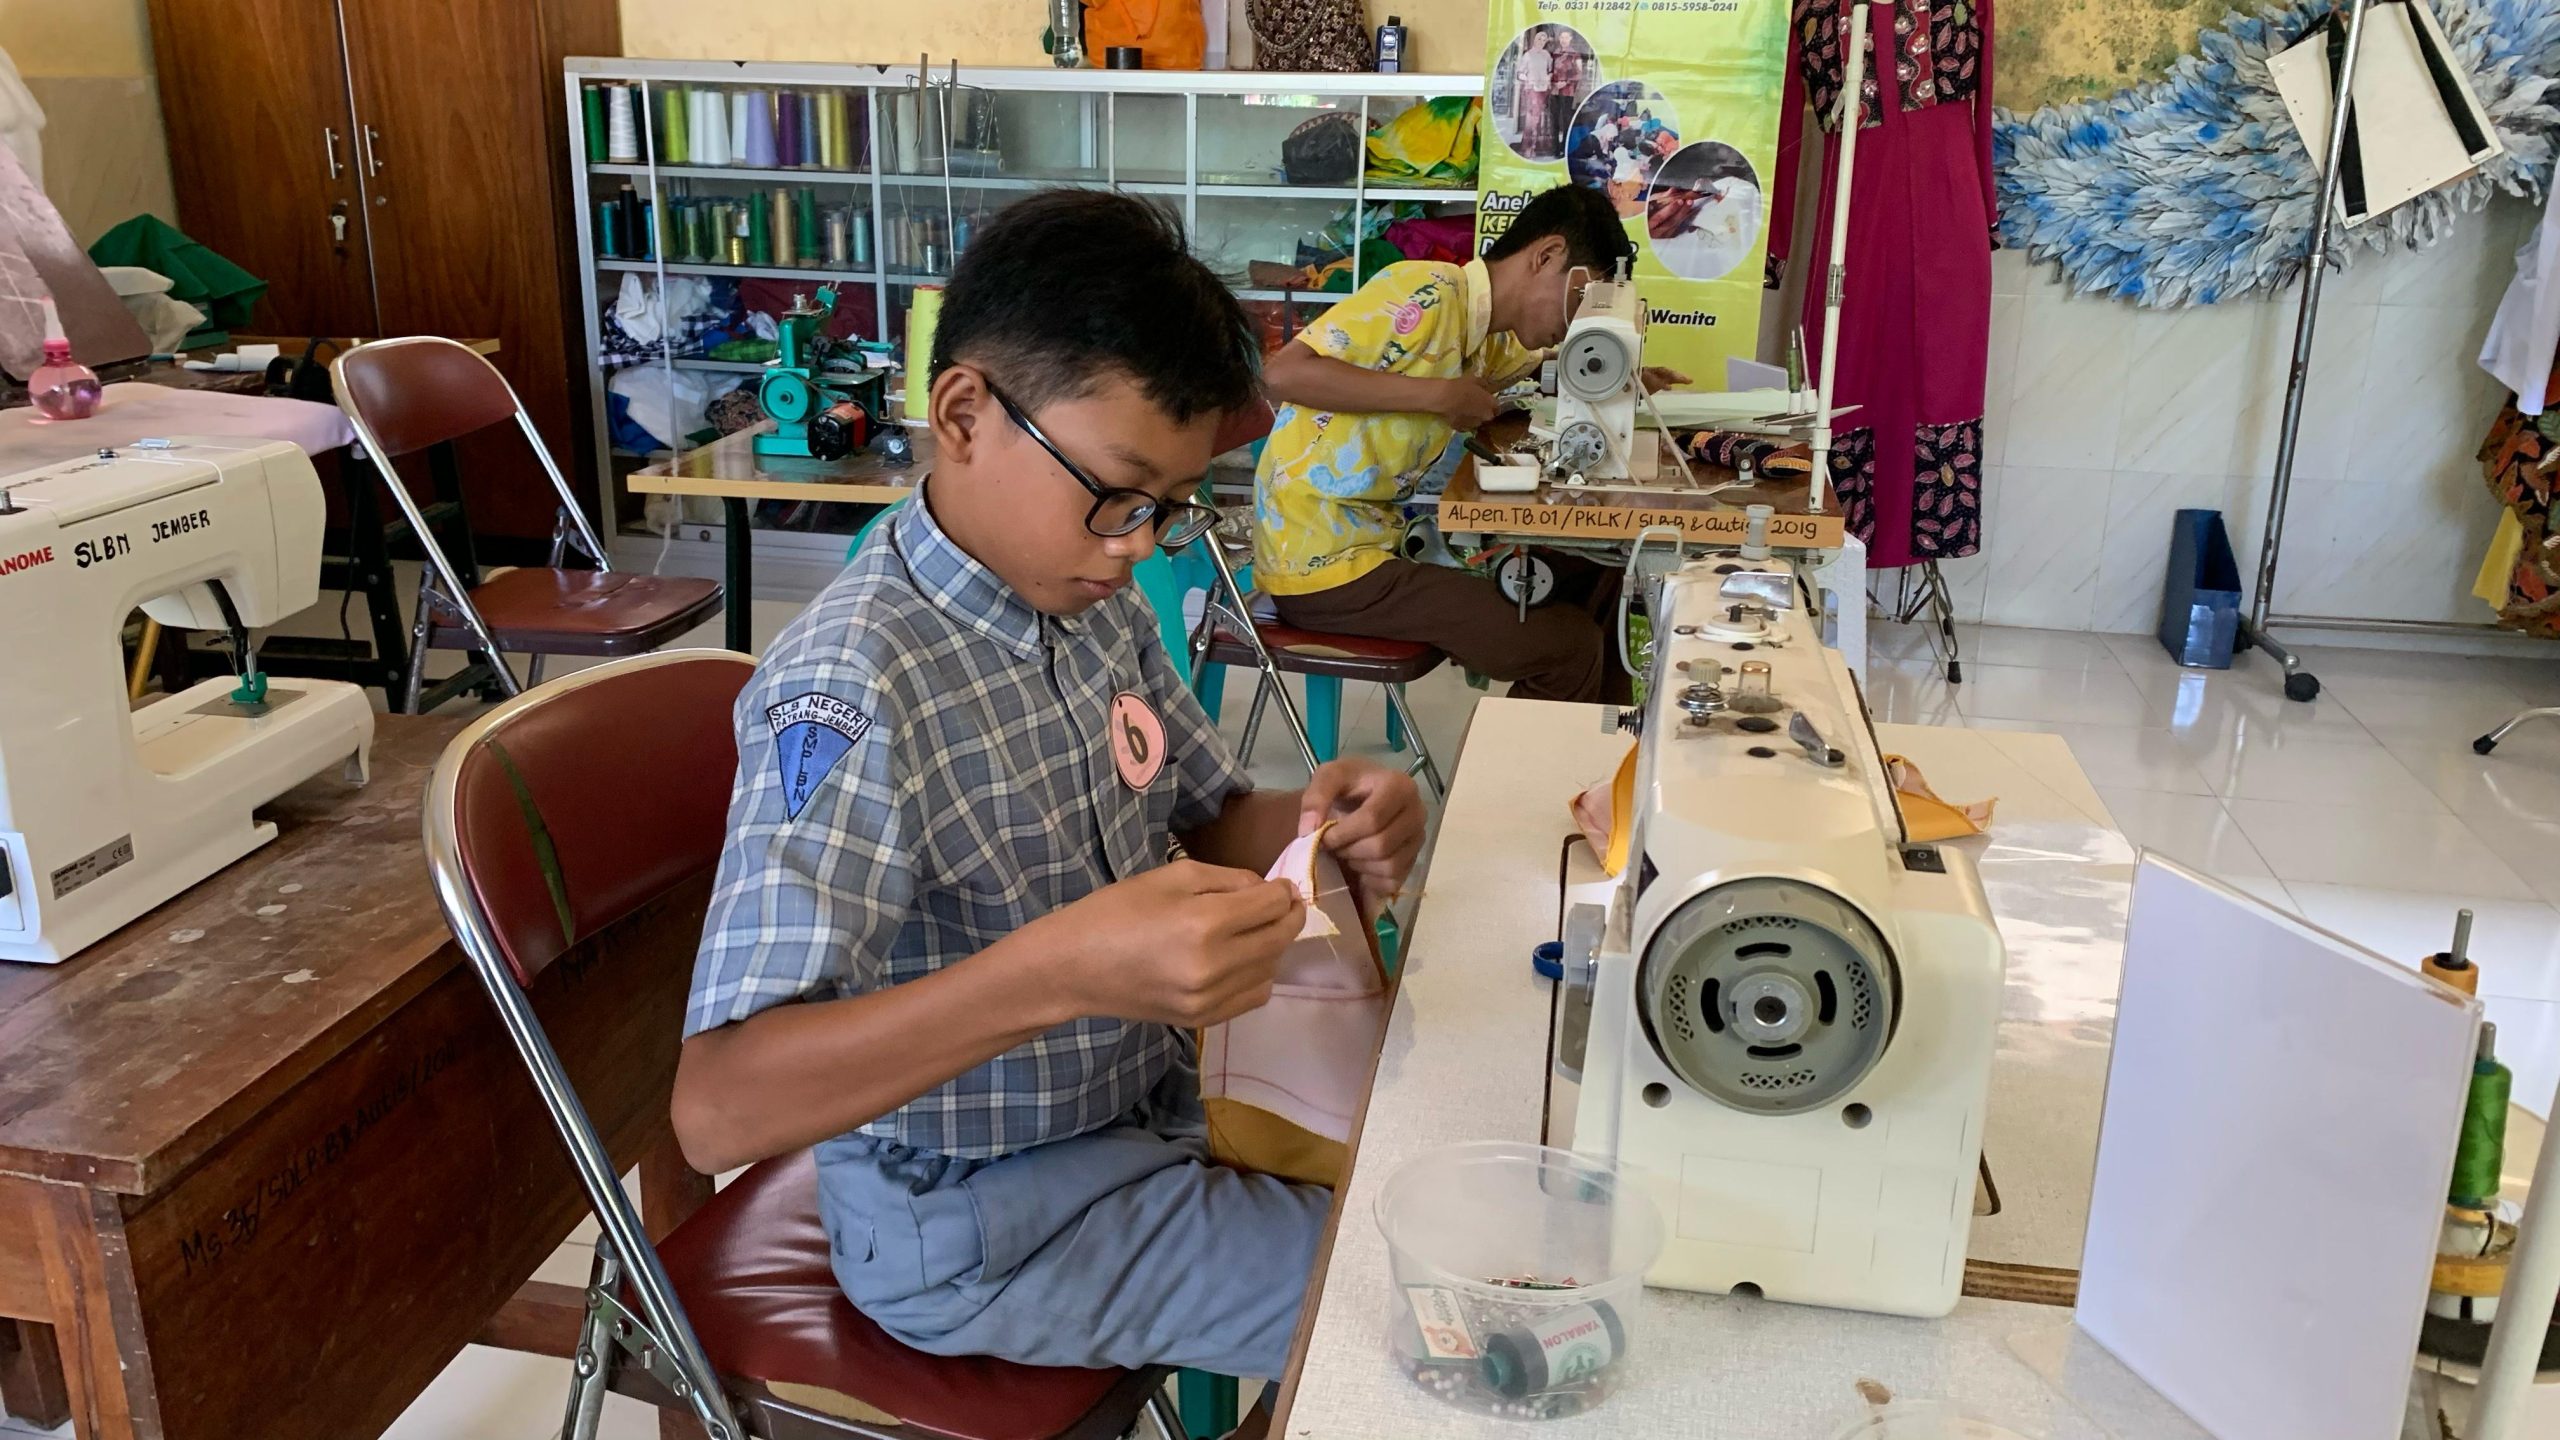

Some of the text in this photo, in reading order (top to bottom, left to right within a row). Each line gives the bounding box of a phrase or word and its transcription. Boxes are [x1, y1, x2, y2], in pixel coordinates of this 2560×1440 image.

[1538, 1, 1560, 12] Telp.
[1565, 2, 1588, 11] 0331
[1593, 2, 1631, 11] 412842
[1651, 2, 1738, 12] 0815-5958-0241
[1650, 308, 1717, 326] Wanita
[74, 509, 211, 568] SLBN JEMBER
[1771, 519, 1817, 539] 2019
[807, 696, 869, 730] NEGERI
[1123, 713, 1148, 764] 6
[1543, 1319, 1600, 1350] YAMALON
